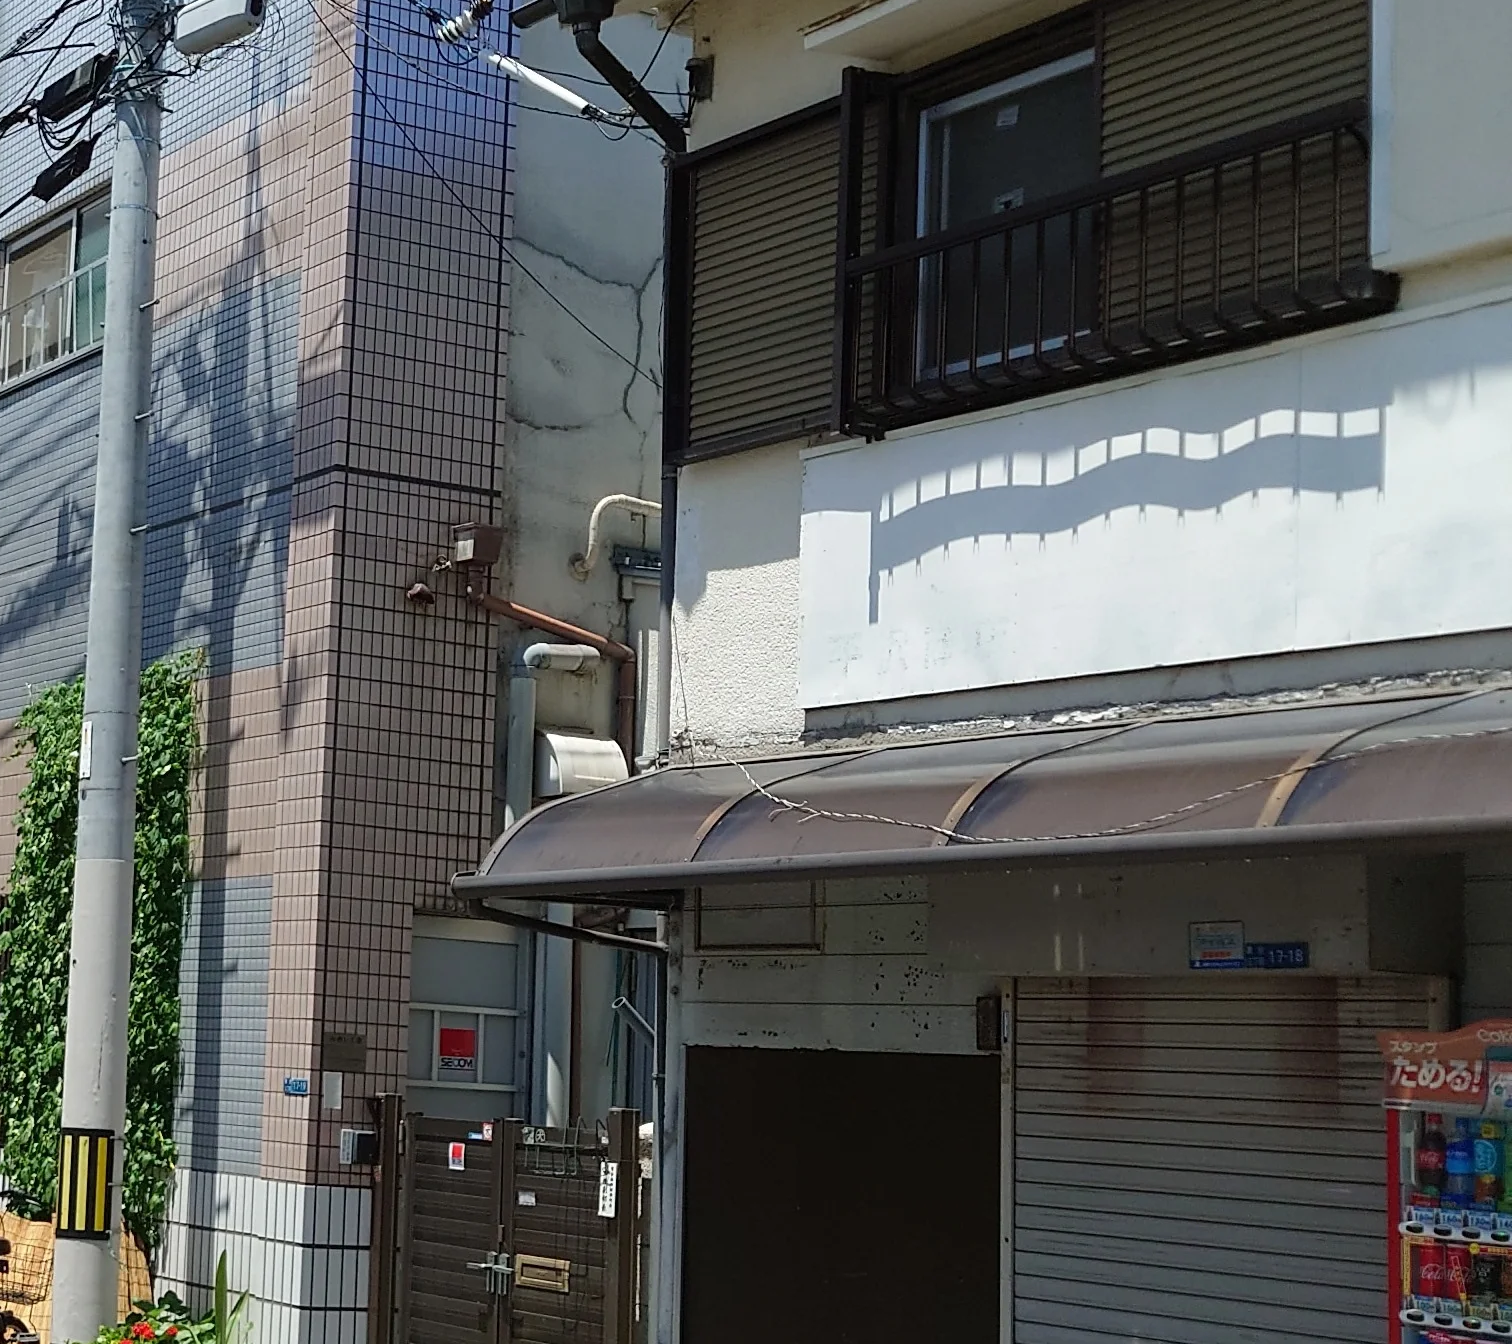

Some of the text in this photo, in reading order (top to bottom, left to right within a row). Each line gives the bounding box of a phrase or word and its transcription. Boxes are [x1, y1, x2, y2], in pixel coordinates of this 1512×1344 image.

[1269, 948, 1304, 964] 17-18
[1389, 1055, 1483, 1094] ためる!
